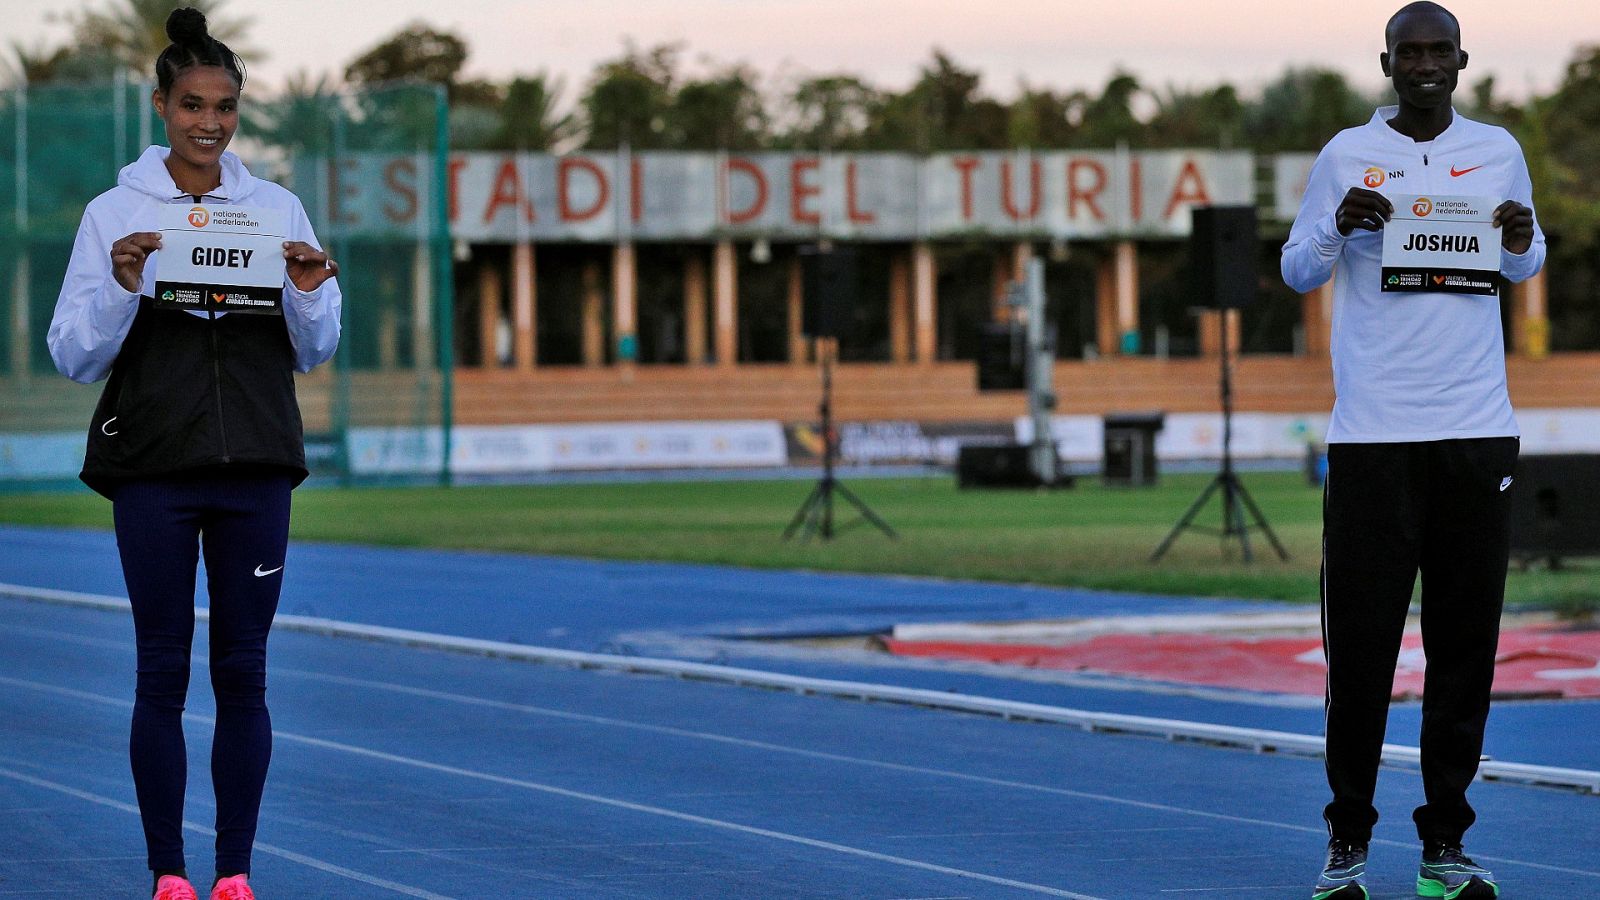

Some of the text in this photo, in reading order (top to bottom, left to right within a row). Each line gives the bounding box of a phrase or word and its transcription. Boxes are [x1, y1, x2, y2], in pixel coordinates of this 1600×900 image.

[1388, 170, 1405, 179] NN
[326, 157, 1213, 224] ESTADI DEL TURIA
[213, 218, 259, 227] nederlanden
[1403, 233, 1480, 253] JOSHUA
[191, 246, 254, 268] GIDEY
